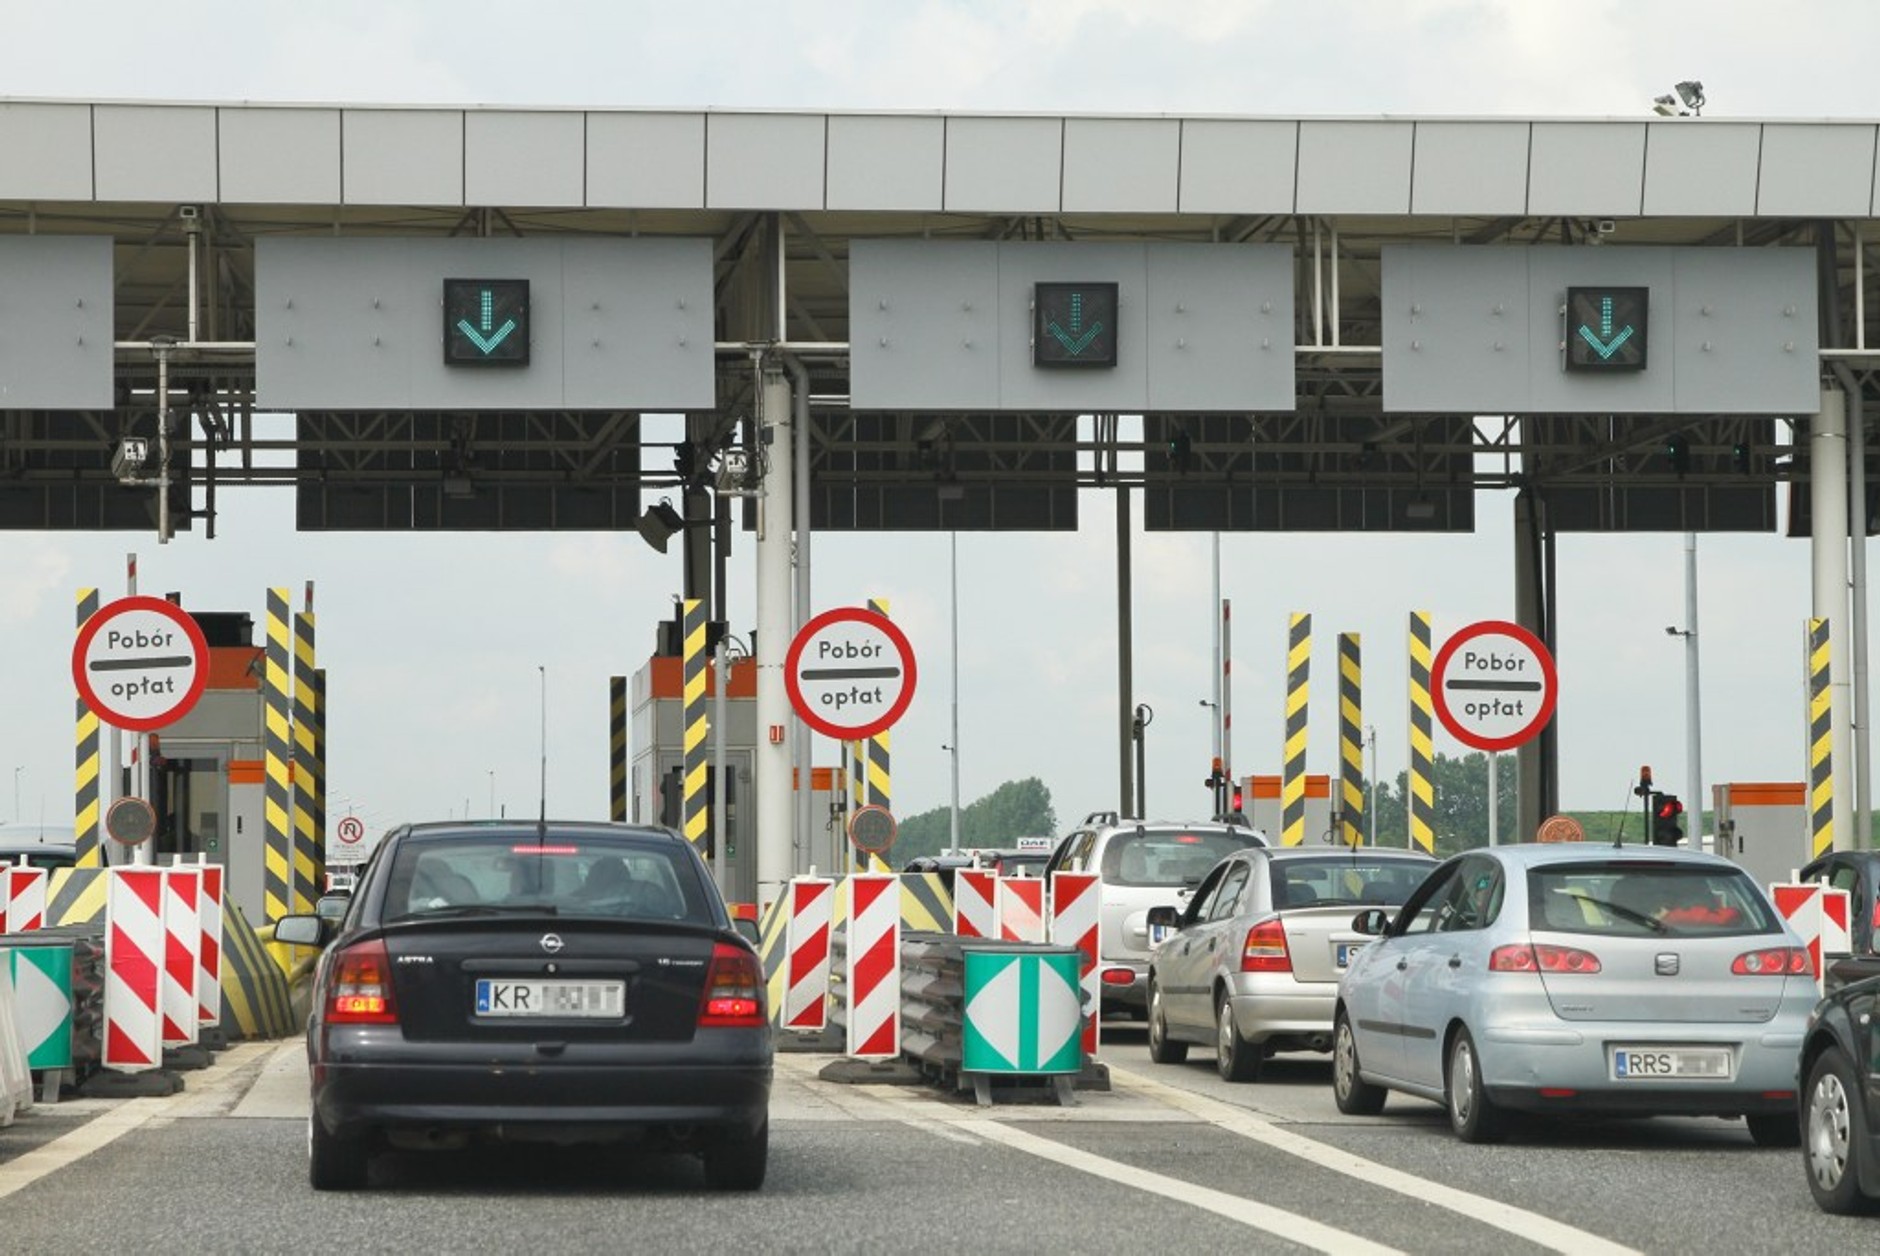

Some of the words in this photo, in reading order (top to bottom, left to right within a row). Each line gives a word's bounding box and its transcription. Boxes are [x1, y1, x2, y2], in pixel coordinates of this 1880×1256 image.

[108, 629, 173, 649] Pobór
[819, 639, 882, 659] Pobór
[1465, 652, 1525, 672] Pobór
[111, 676, 174, 701] opłat
[821, 687, 882, 711] opłat
[1465, 698, 1524, 721] opłat
[493, 985, 531, 1009] KR
[1629, 1053, 1672, 1074] RRS
